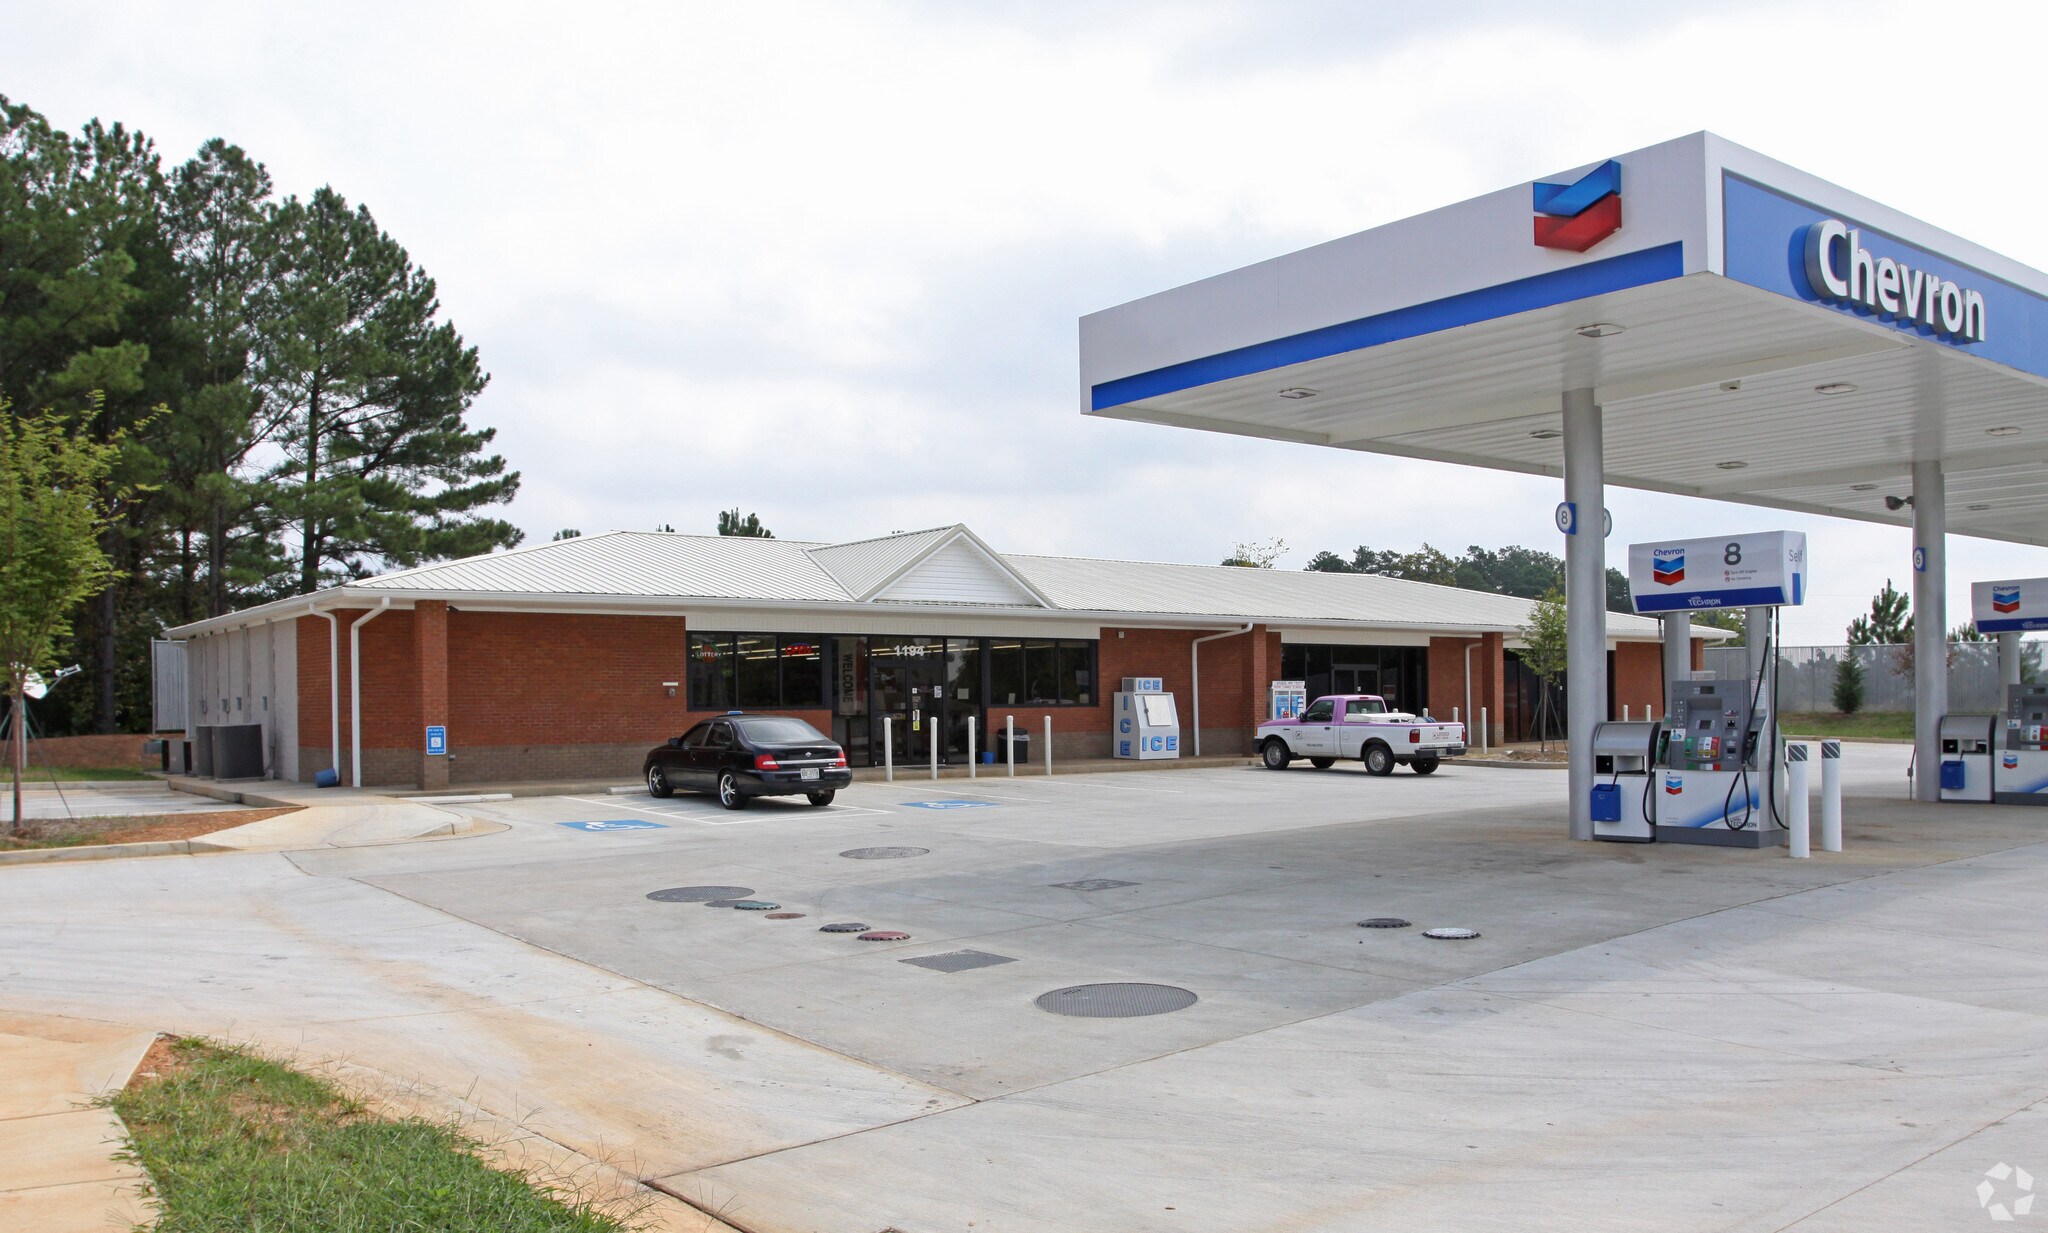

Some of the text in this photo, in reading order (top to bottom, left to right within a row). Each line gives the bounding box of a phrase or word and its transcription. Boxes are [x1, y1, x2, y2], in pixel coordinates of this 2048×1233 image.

[1805, 218, 1985, 343] Chevron
[1560, 510, 1568, 525] 8
[1653, 548, 1685, 556] Chevron
[1724, 542, 1742, 566] 8
[1916, 553, 1921, 565] 6
[1688, 599, 1722, 607] TECHRON
[696, 651, 721, 659] LOTTERY
[894, 645, 925, 656] 1194
[843, 654, 853, 703] WELCOME
[1138, 680, 1160, 690] ICE
[1120, 695, 1131, 756] ICE
[1142, 735, 1177, 751] ICE
